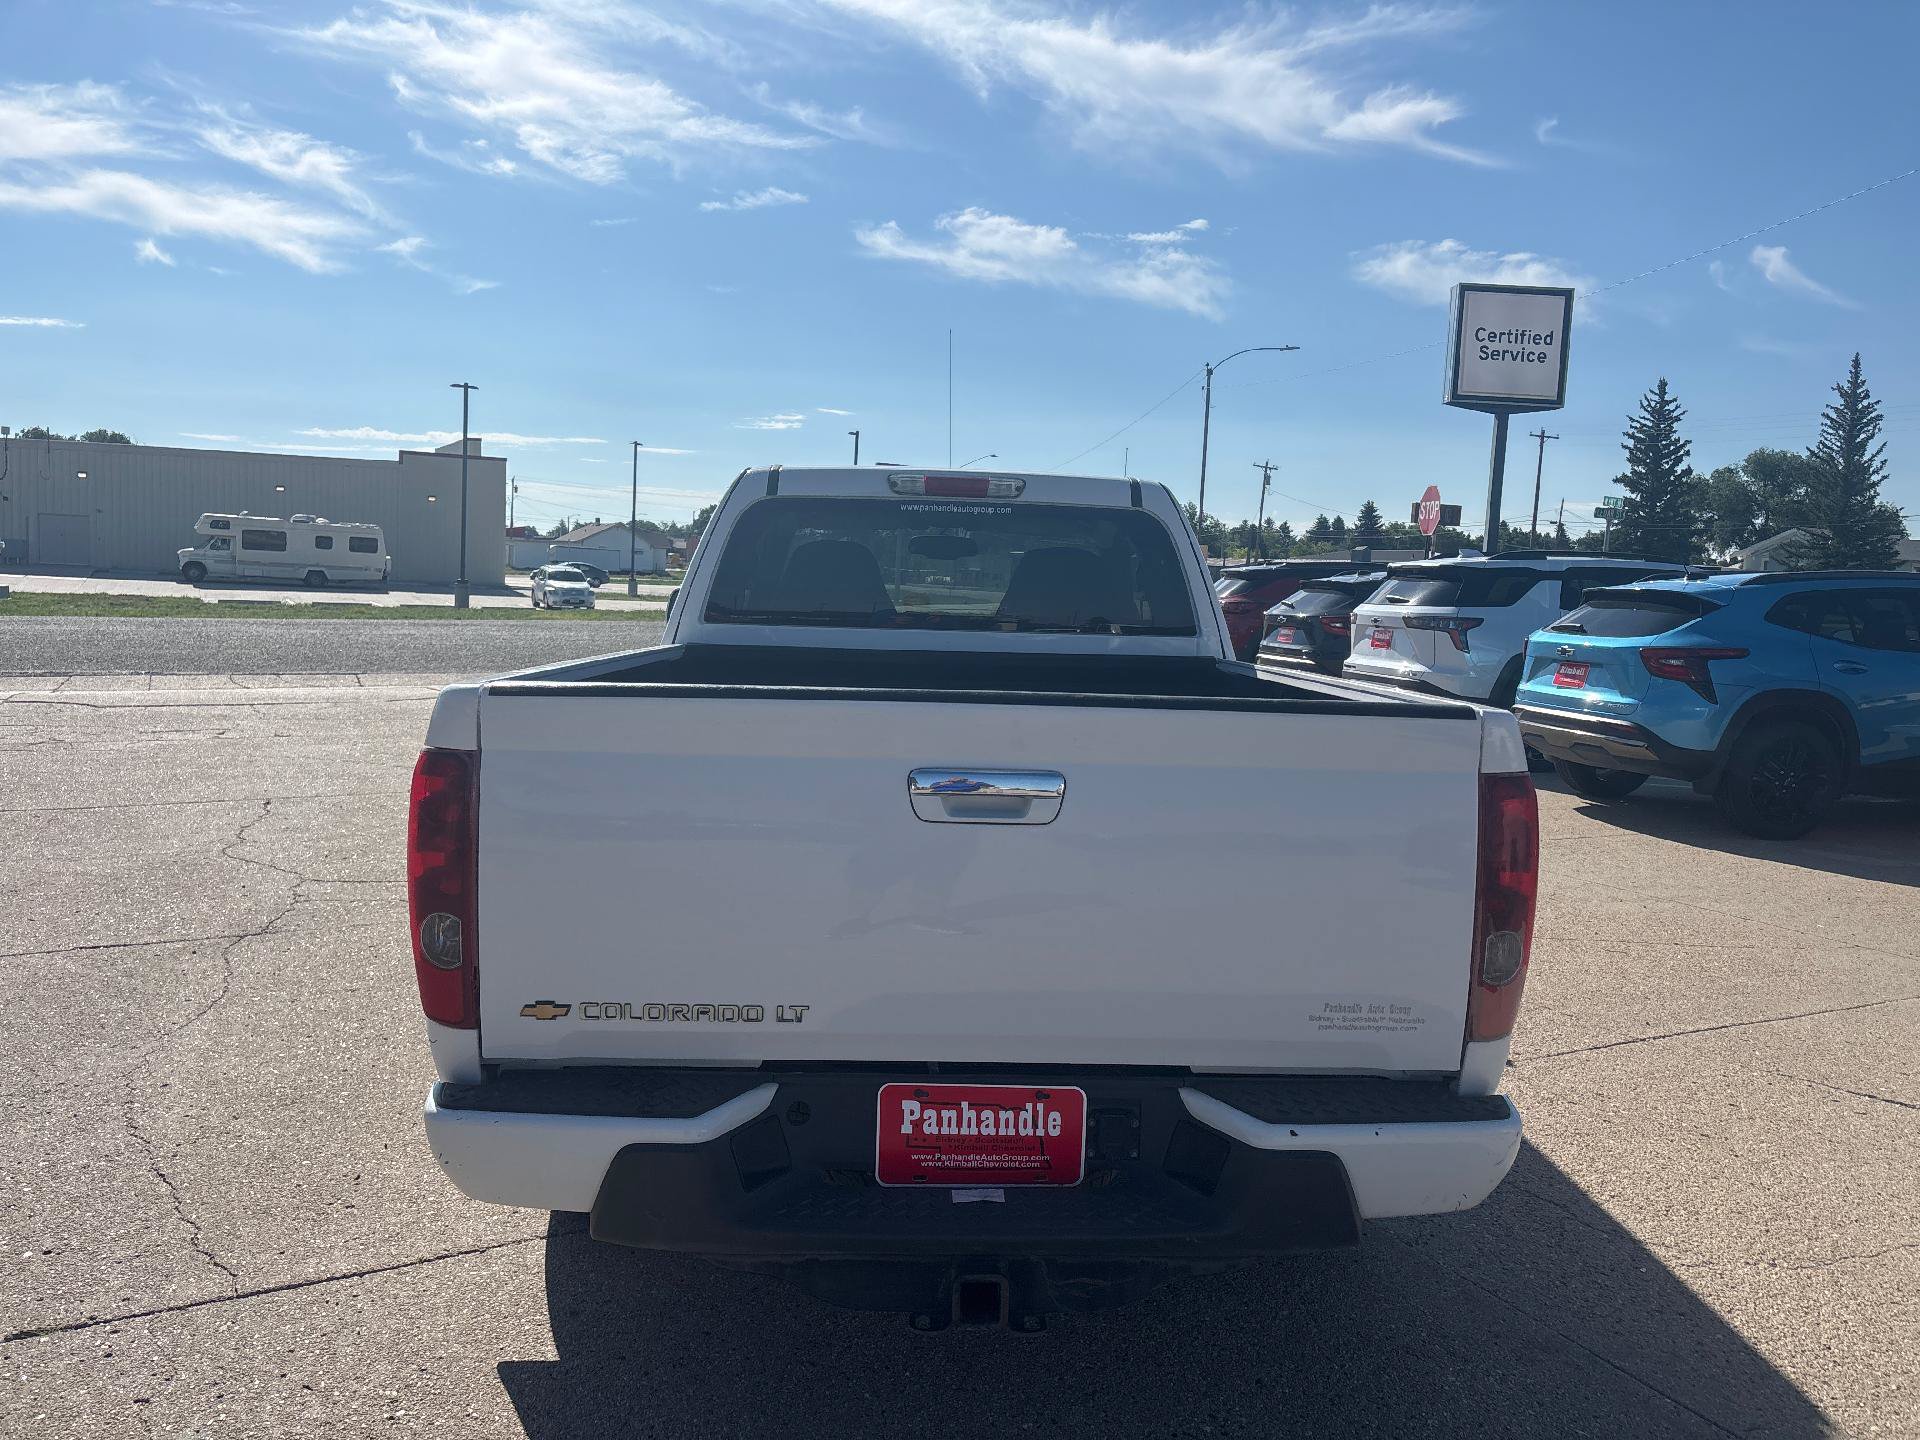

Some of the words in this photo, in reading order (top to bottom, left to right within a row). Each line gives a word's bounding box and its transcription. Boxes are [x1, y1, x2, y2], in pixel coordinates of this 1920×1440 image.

[1474, 326, 1554, 346] Certified
[1478, 345, 1548, 364] Service
[900, 503, 1012, 515] www.panhandleautogroup.com
[1420, 500, 1440, 520] STOP
[578, 1001, 765, 1024] COLORADO
[775, 1004, 810, 1024] LT
[900, 1099, 1062, 1137] Panhandle
[911, 1153, 1050, 1162] www.PanhandleAutoGroup.com
[920, 1160, 1041, 1169] www.KimballChevrolet.com
